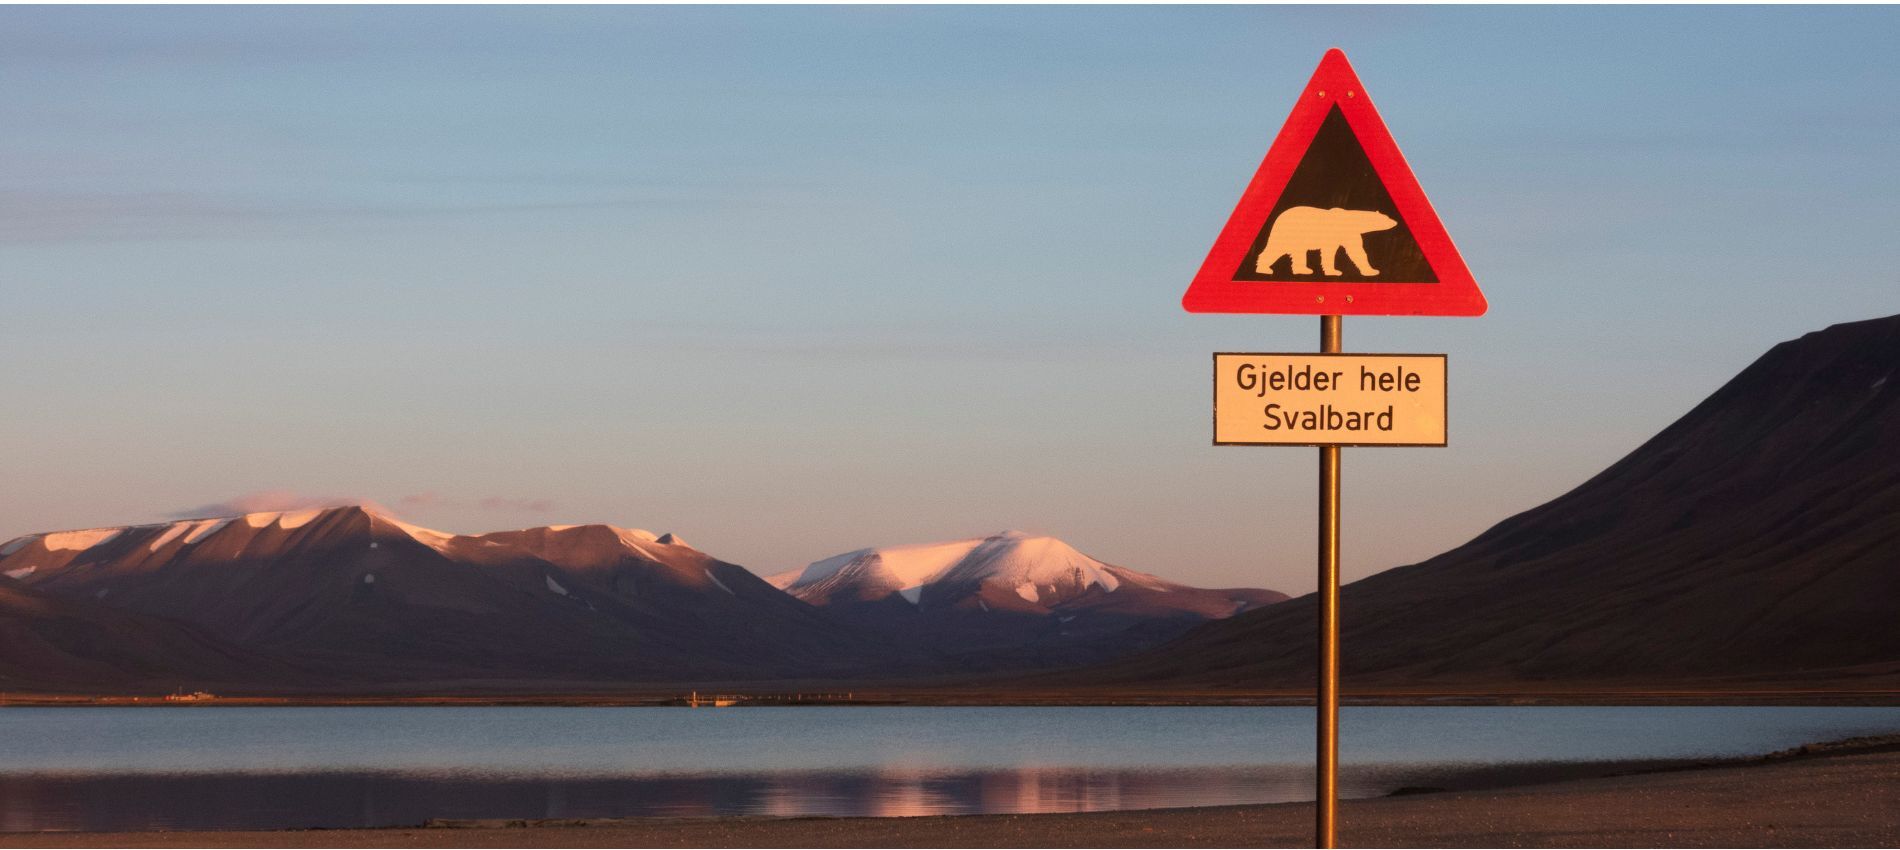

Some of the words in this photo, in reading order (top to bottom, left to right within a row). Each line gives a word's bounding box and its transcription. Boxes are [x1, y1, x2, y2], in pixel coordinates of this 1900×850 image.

[1236, 363, 1343, 397] Gjelder
[1360, 365, 1421, 392] hele
[1263, 403, 1393, 431] Svalbard
